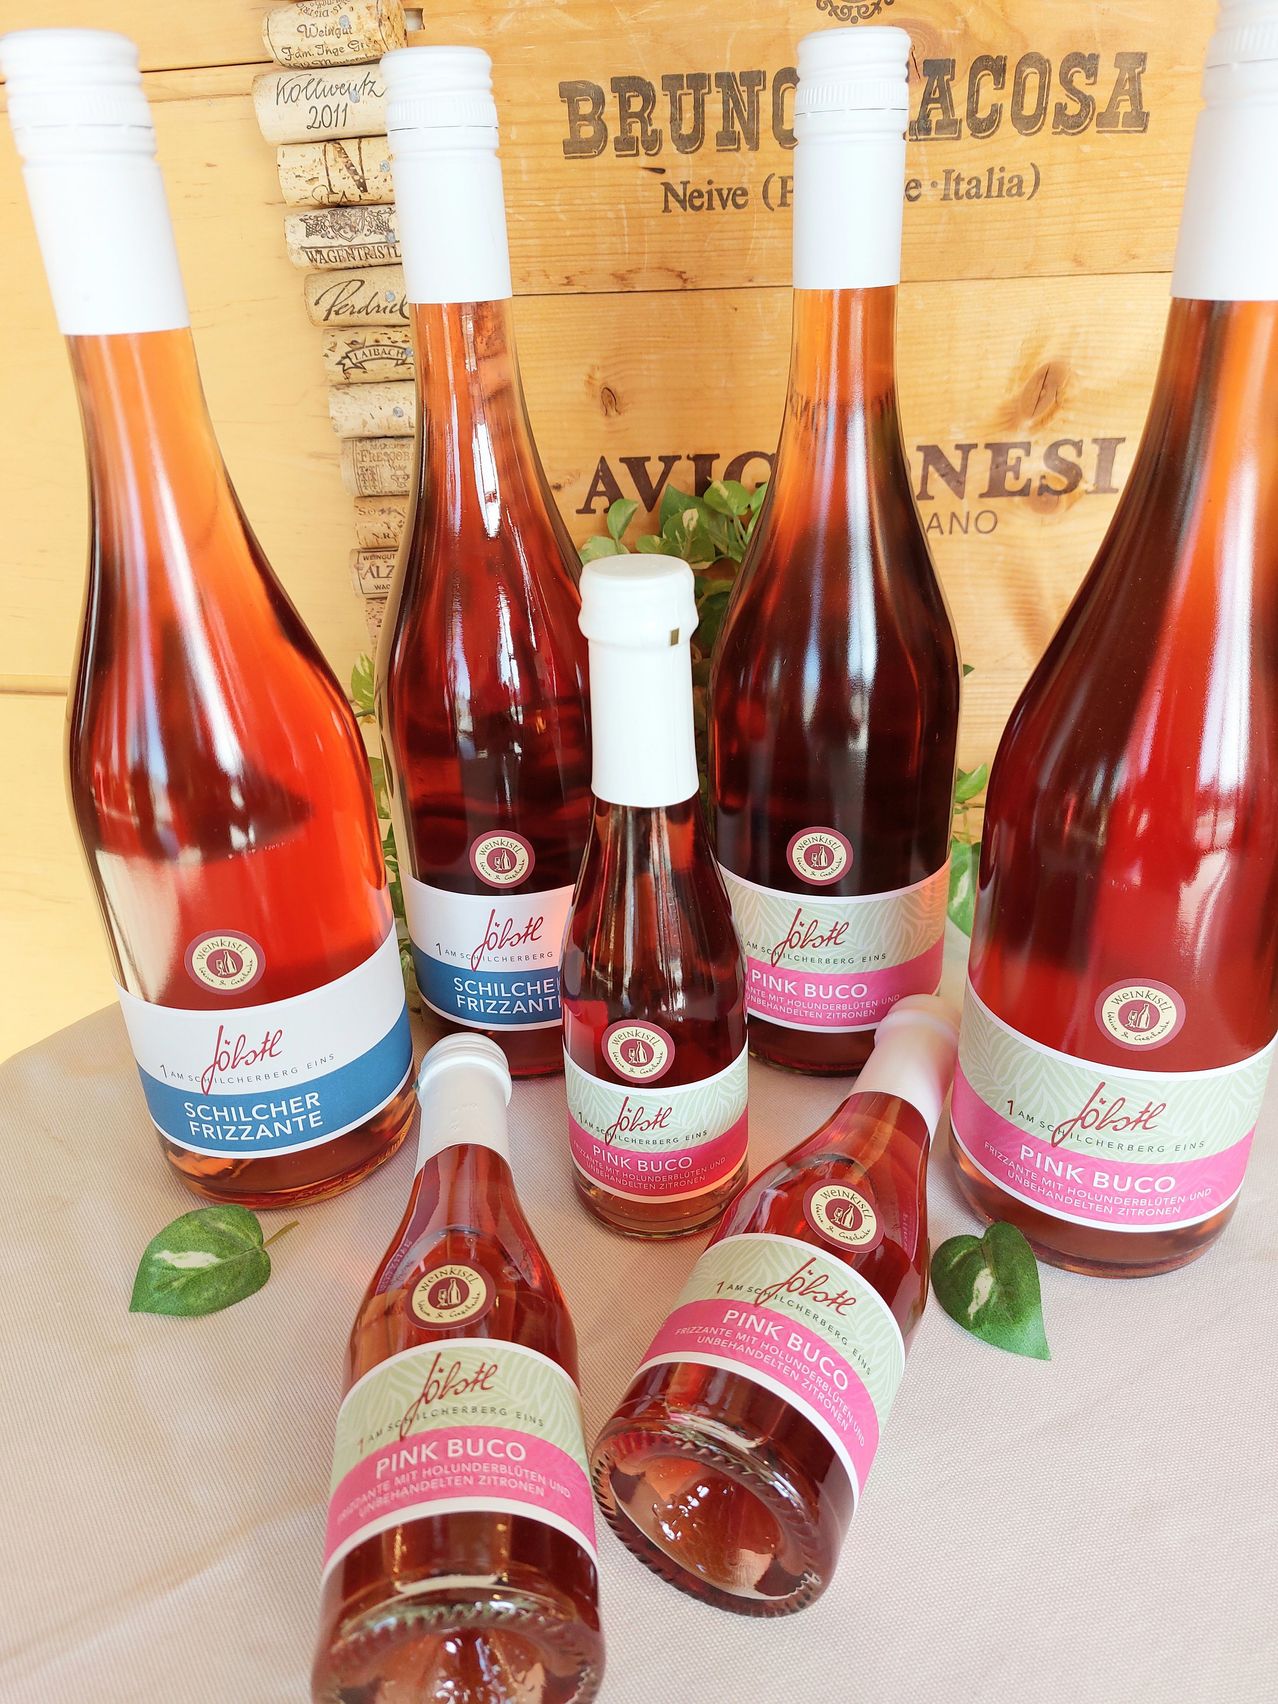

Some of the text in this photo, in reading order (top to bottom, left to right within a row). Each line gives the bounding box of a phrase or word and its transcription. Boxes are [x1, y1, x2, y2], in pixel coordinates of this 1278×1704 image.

[306, 102, 348, 130] 2011
[660, 179, 748, 214] Neive
[353, 347, 405, 361] LAIBACH
[436, 942, 553, 962] 1 AM SCHILCHERBERG
[746, 941, 758, 950] AM
[861, 953, 887, 963] EINS
[453, 977, 560, 997] SCHILCHE
[751, 969, 868, 999] PINK BUCO
[768, 994, 784, 1003] MIT
[787, 998, 878, 1011] HOLUNDERBLÜTEN
[826, 1009, 876, 1020] ZITRONEN
[160, 1053, 335, 1084] 1 AM SCHILCHERBERG EINS
[183, 1092, 321, 1122] SCHILCHER
[189, 1110, 324, 1141] FRIZZANTE
[584, 1120, 594, 1129] AM
[685, 1130, 708, 1141] EINS
[1007, 1100, 1206, 1153] 1 AM SCHILCHERBERG EINS
[592, 1145, 693, 1173] PINK BUCO
[605, 1166, 620, 1176] MIT
[709, 1156, 727, 1171] UND
[983, 1141, 1212, 1207] FRIZZANTE MIT HOLUNDERBLÜTEN UND
[1020, 1143, 1176, 1194] PINK BUCO
[586, 1161, 706, 1190] UNBEHANDELTEN ZITRONEN
[1007, 1171, 1181, 1217] UNBEHANDELTEN ZITRONEN
[716, 1281, 871, 1375] 1 AM SCHILCHERBERG EINS
[722, 1309, 849, 1391] PINK BUCO
[675, 1326, 866, 1447] FRIZZANTE MIT HOLUNDERBLÜTEN UND
[696, 1335, 849, 1431] UNBEHANDELTEN ZITRONEN
[367, 1430, 383, 1442] AM
[515, 1411, 545, 1428] EINS
[375, 1438, 527, 1480] PINK BUCO
[393, 1469, 418, 1486] MIT
[421, 1462, 546, 1485] HOLUNDERBLÜTEN
[549, 1479, 571, 1499] UND
[478, 1475, 545, 1497] ZITRONEN
